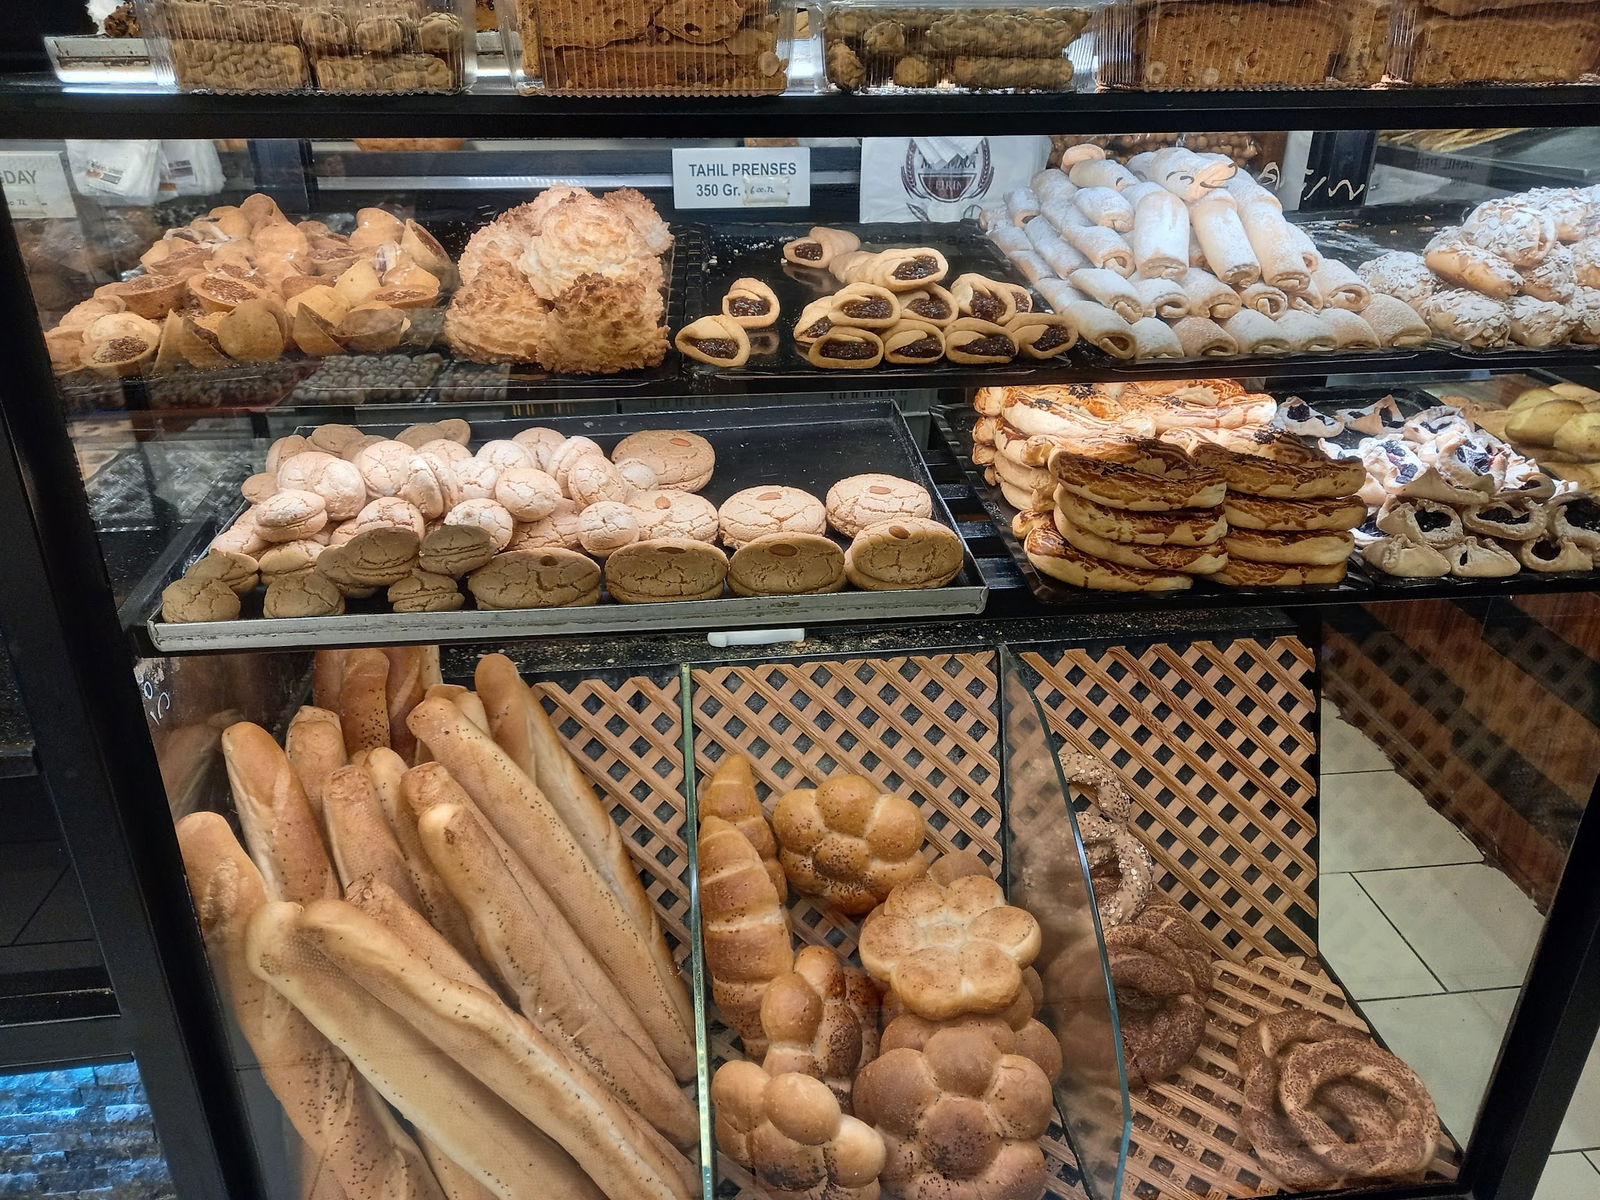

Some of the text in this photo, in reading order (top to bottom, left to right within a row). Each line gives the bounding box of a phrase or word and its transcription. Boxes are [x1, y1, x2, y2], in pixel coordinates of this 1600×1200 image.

[688, 162, 797, 177] TAHIL PRENSES
[696, 183, 741, 197] 350 Gr.
